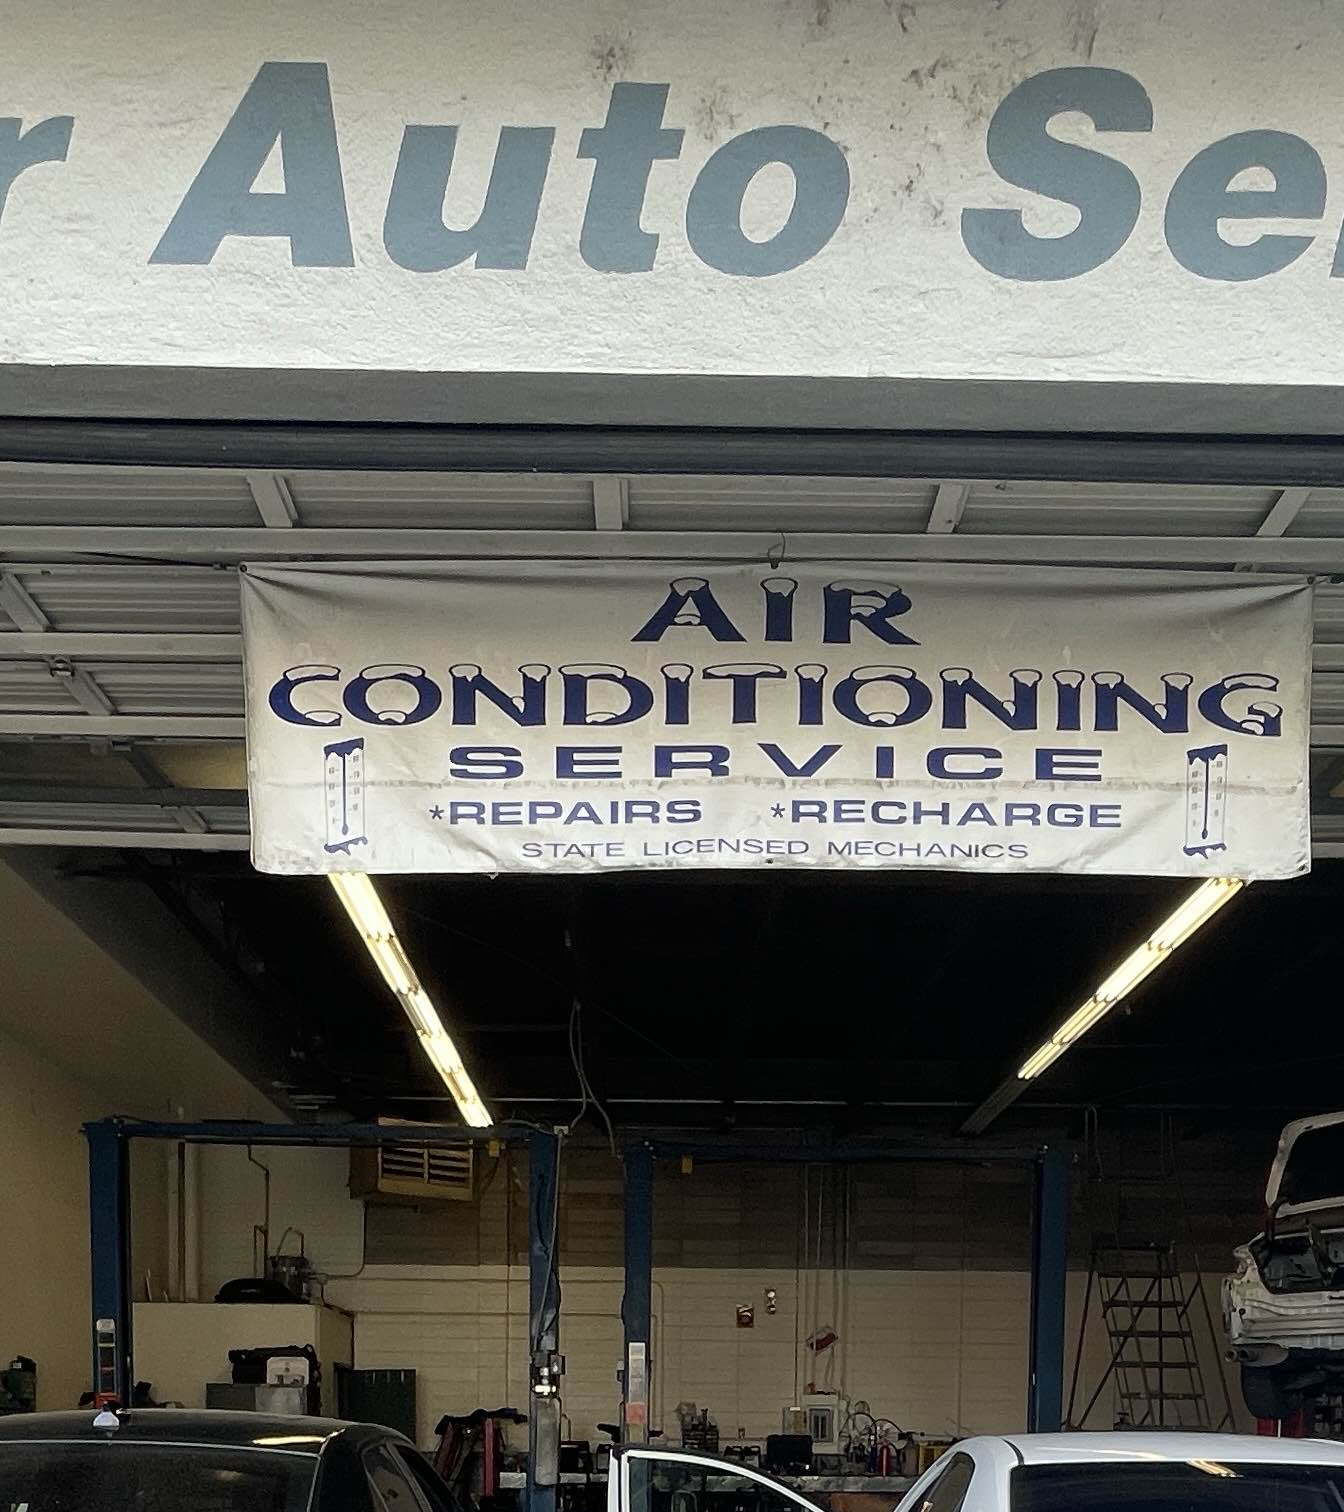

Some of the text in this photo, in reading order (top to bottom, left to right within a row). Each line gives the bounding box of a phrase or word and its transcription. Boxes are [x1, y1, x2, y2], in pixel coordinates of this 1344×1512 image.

[147, 61, 850, 278] Auto
[631, 577, 921, 645] AIR
[268, 663, 1284, 737] CONDITIONING
[449, 743, 1103, 781] SERVICE
[449, 799, 1122, 828] REPAIRS RECHARGE
[522, 838, 1029, 859] STATE LICENSED MECHANICS
